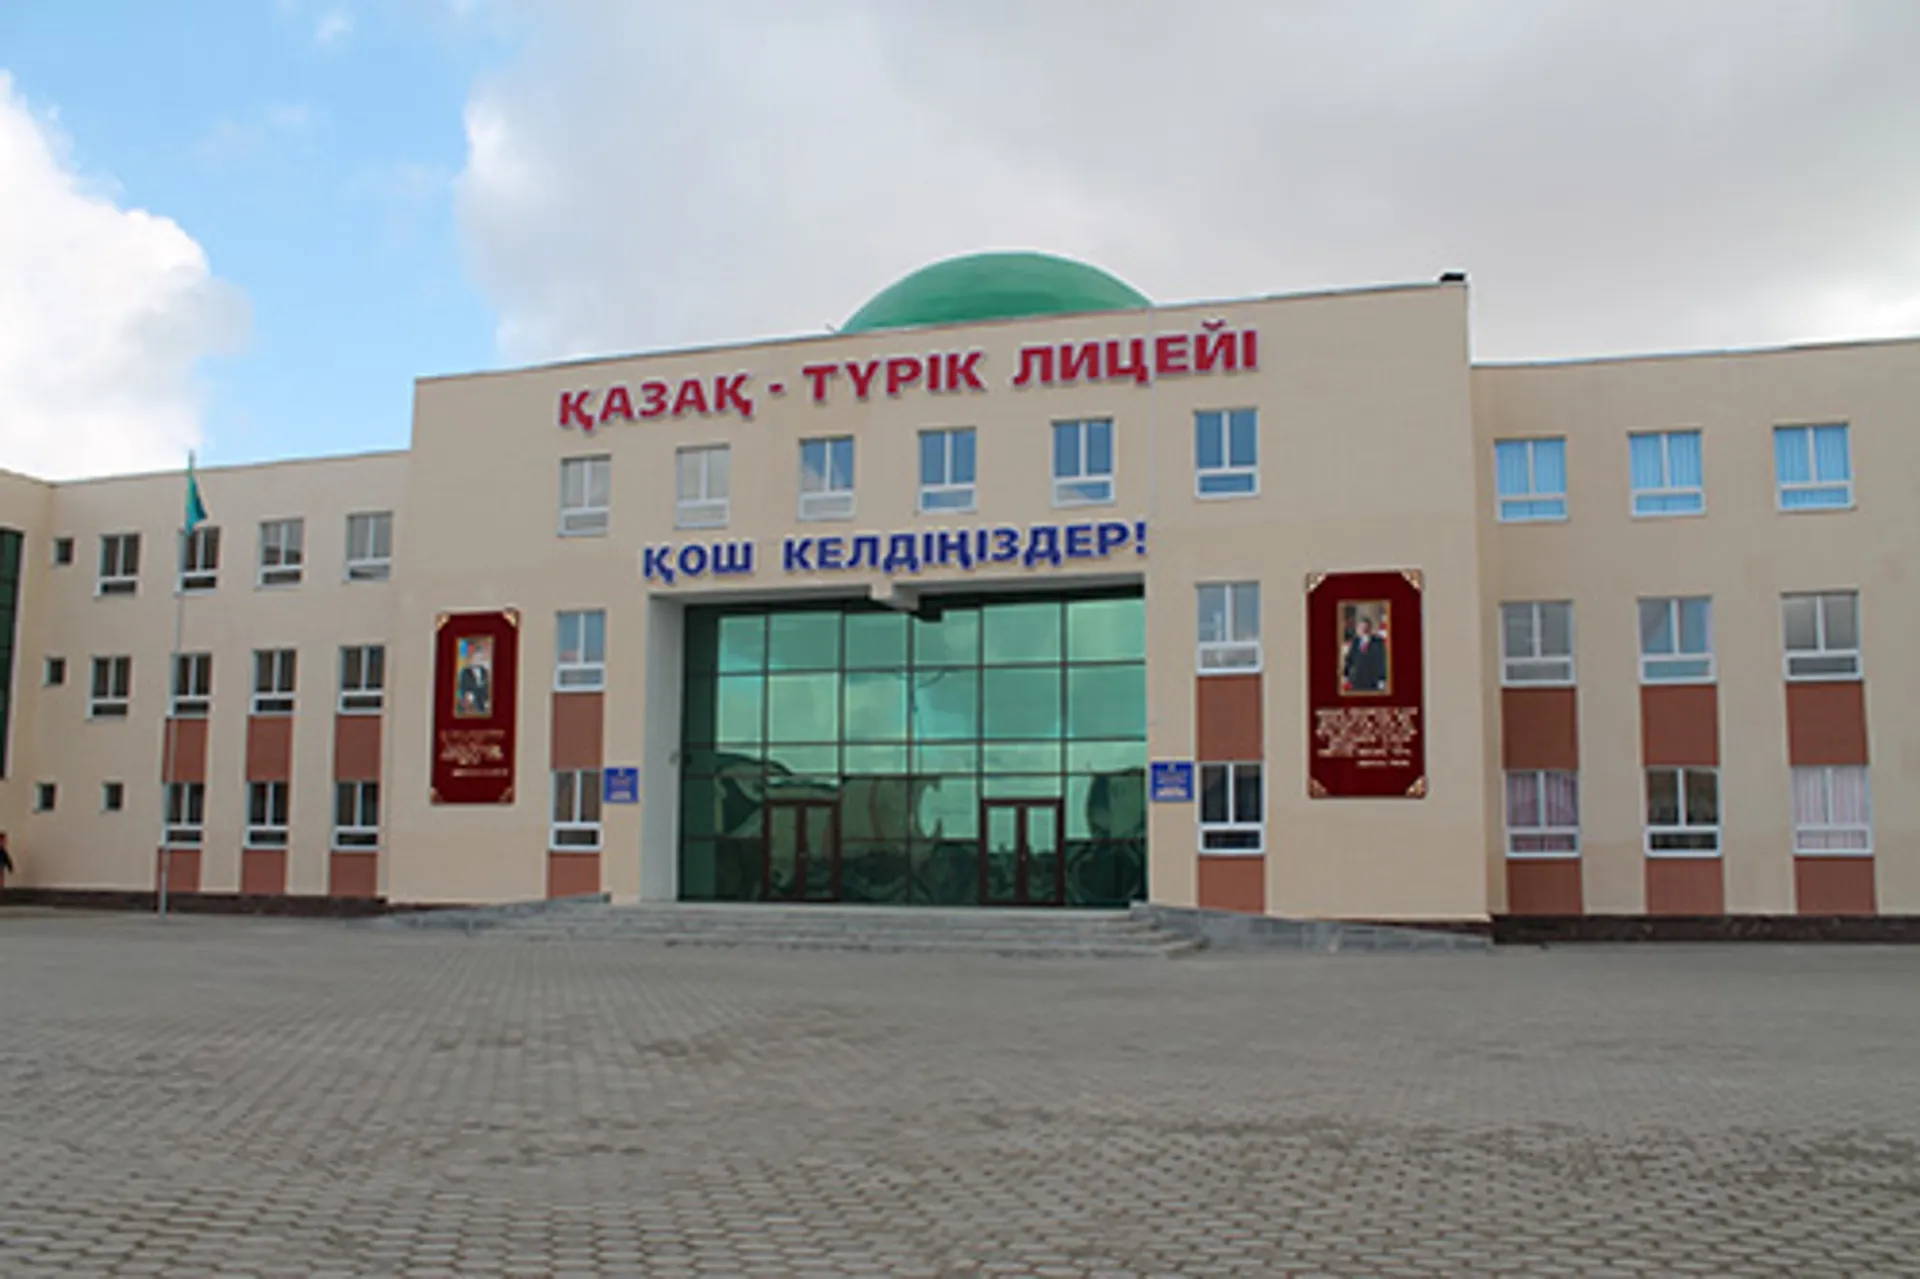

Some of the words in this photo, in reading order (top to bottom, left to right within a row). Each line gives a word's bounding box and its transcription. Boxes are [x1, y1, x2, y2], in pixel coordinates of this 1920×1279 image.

[559, 371, 754, 431] ҚАЗАҚ
[1013, 319, 1258, 385] ЛИЦЕЙІ
[643, 540, 754, 584] ҚОШ
[783, 521, 1147, 573] КЕЛДІҢІЗДЕР!
